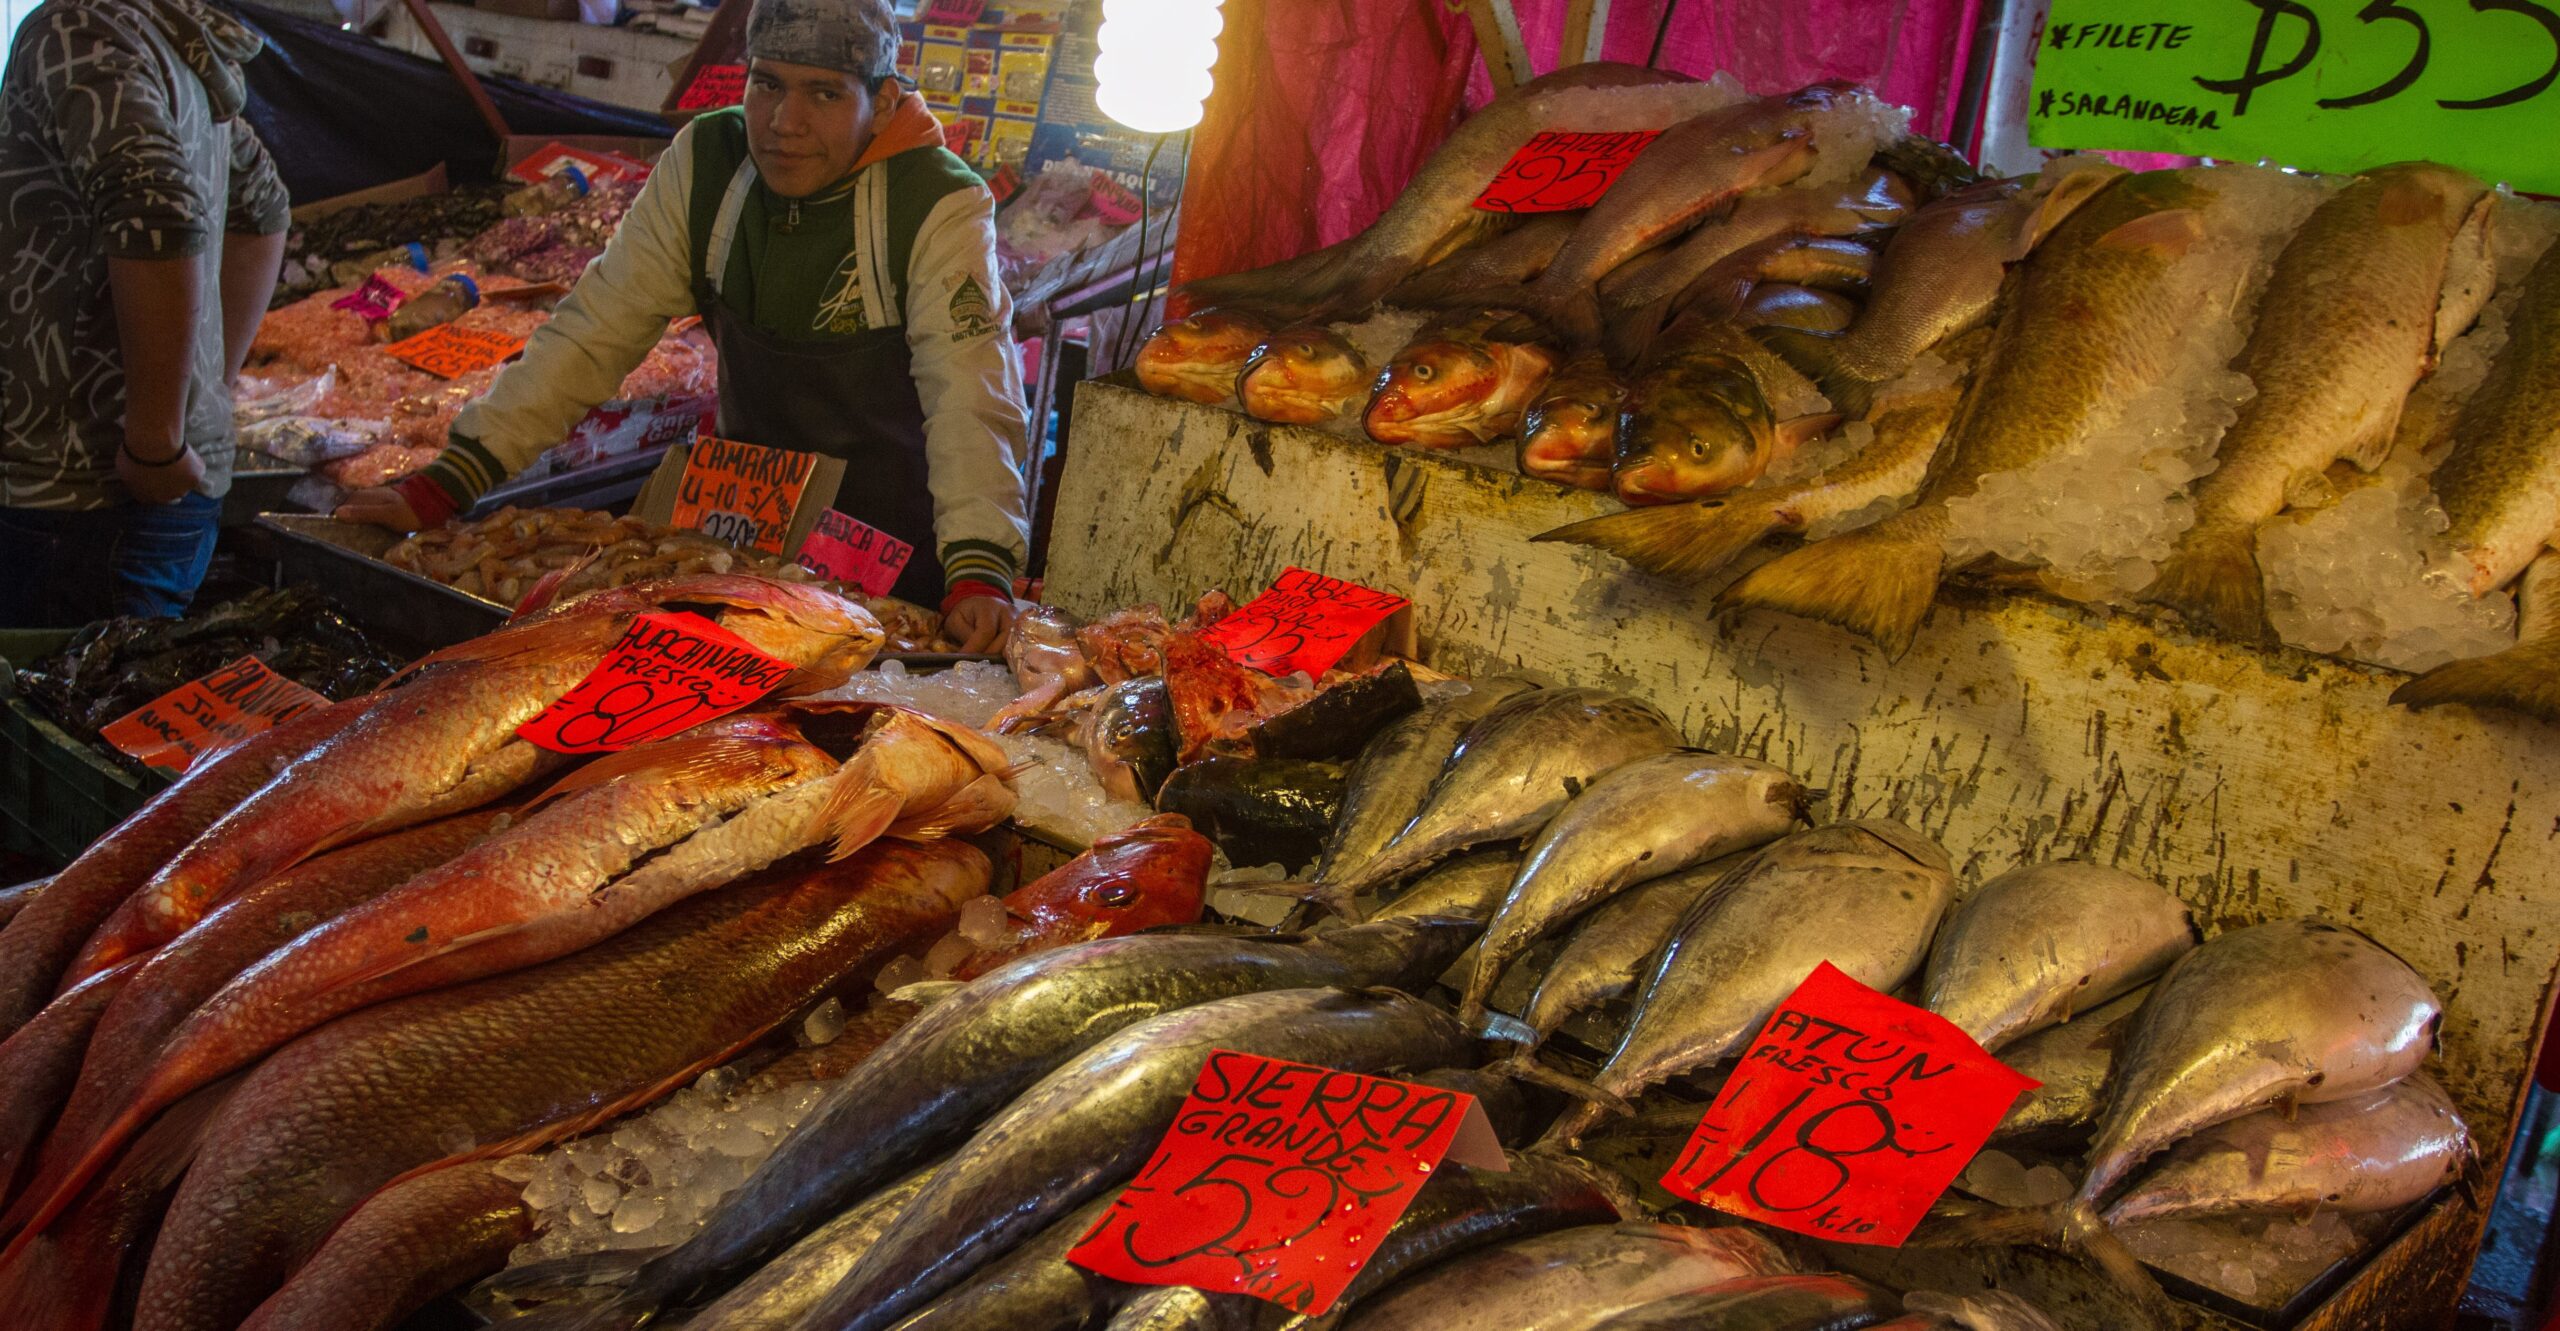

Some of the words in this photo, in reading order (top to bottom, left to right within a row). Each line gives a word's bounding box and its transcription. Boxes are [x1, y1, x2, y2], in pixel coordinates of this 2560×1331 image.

[2074, 23, 2193, 51] FILETE
[2058, 92, 2222, 131] SARANDEAR
[693, 438, 809, 487] CAMARON
[1271, 569, 1407, 611] CABEZA
[608, 655, 713, 692] FRESCO
[1748, 1044, 1894, 1101] FRESCO
[1192, 1053, 1458, 1151] SIERRA
[1177, 1110, 1390, 1173] GRANDE
